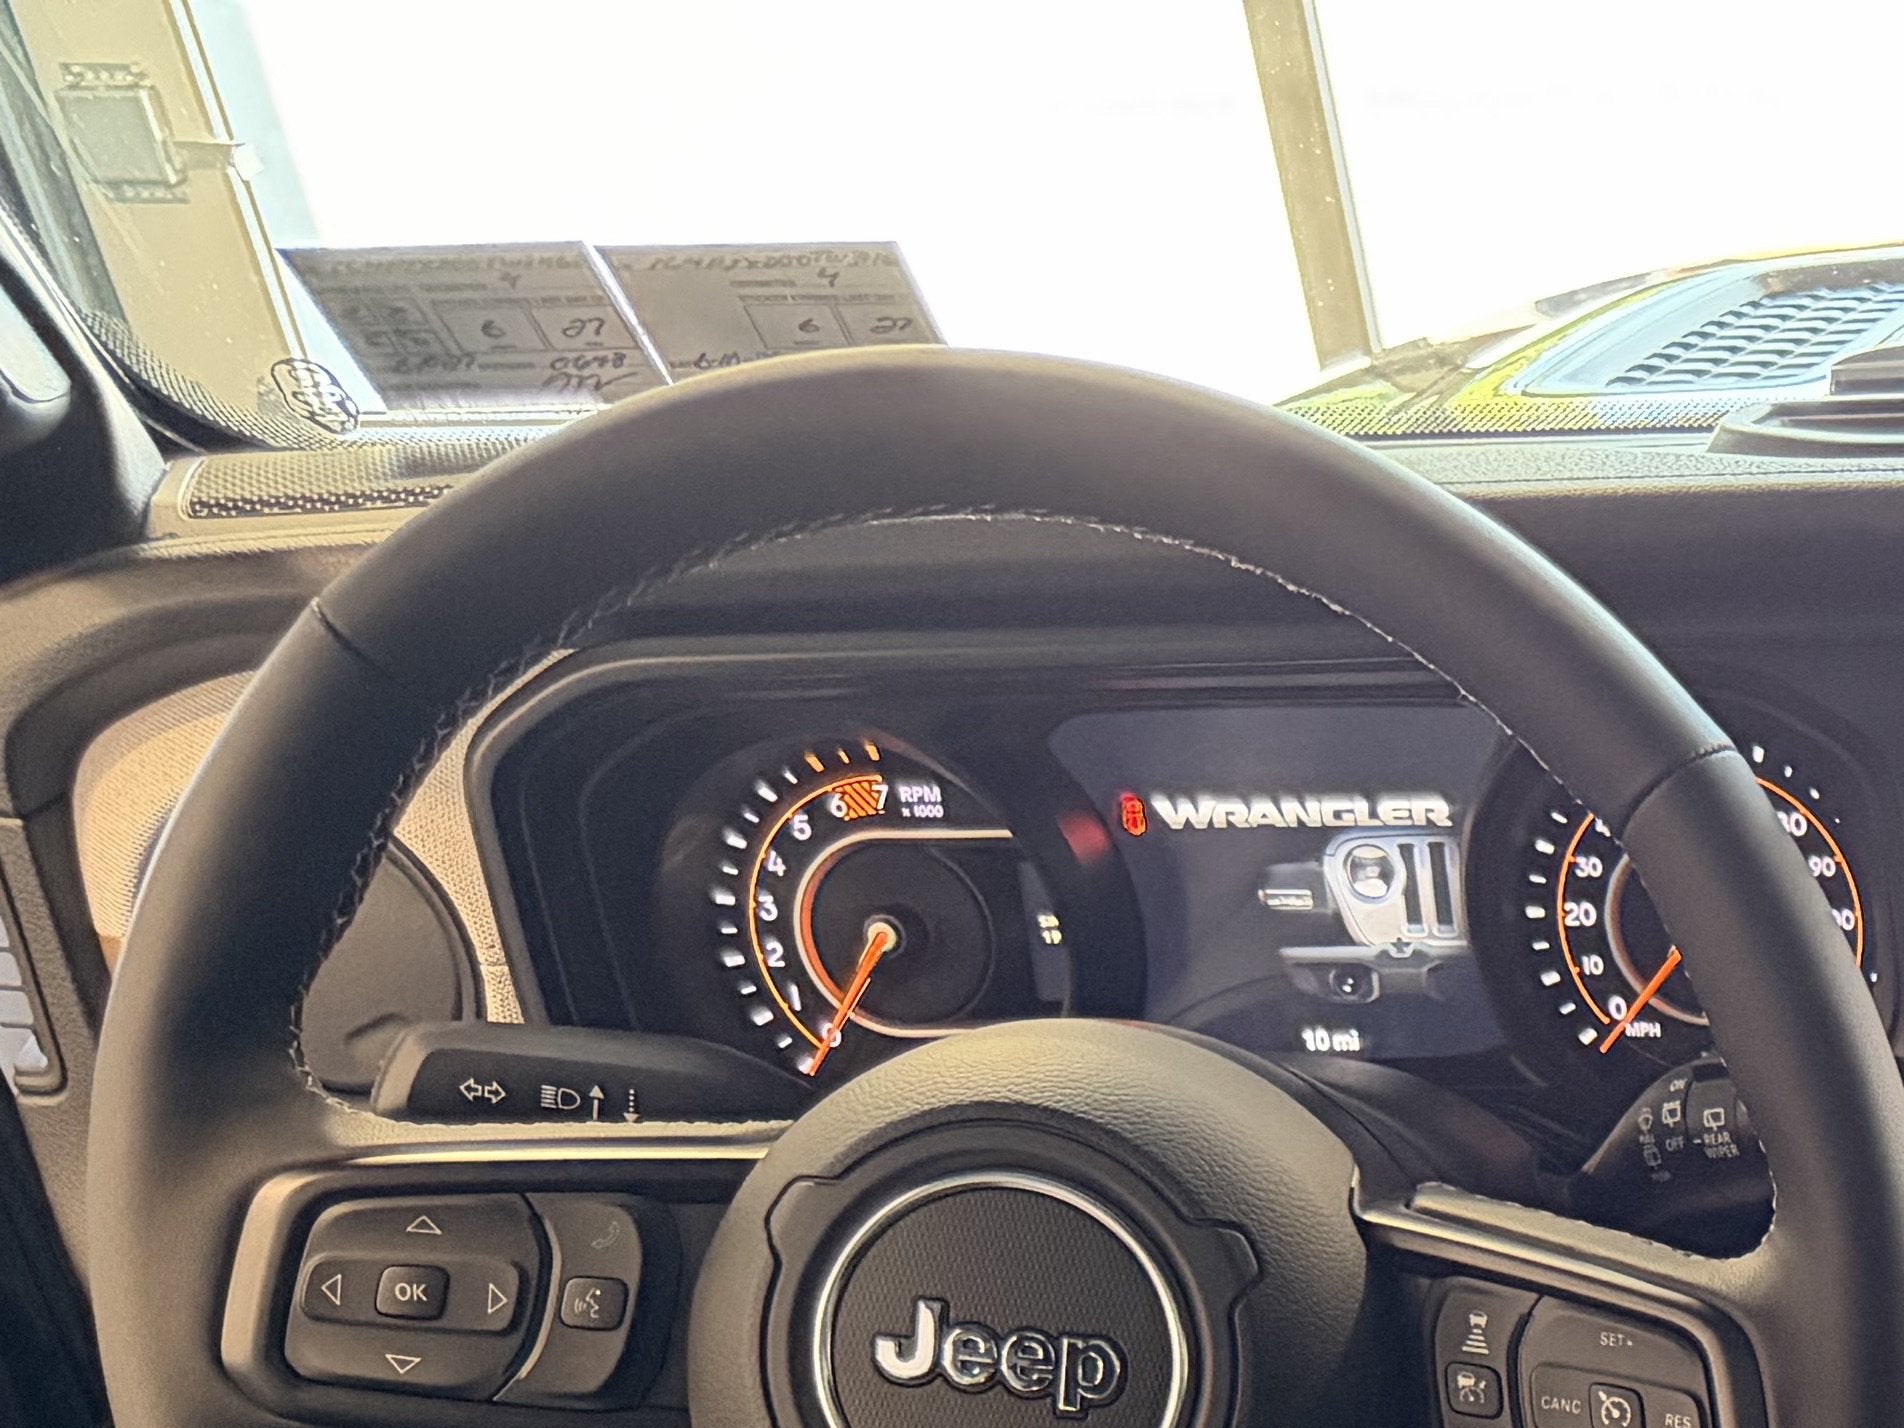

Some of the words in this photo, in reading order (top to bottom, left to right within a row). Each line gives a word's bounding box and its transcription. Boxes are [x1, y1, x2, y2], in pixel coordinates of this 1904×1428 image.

[798, 317, 821, 333] 6
[830, 791, 848, 818] 6
[873, 784, 889, 810] 7
[900, 785, 942, 803] RPM
[912, 805, 944, 818] 1000
[1152, 795, 1453, 829] WRANGLER
[793, 815, 812, 840] 5
[767, 851, 787, 877] 4
[1574, 855, 1603, 878] 30
[1808, 855, 1836, 877] 90
[757, 895, 779, 921] 3
[1563, 901, 1597, 927] 20
[764, 942, 785, 967] 2
[1582, 955, 1604, 976] 10
[787, 984, 802, 1011] 1
[1608, 994, 1628, 1021] 0
[1302, 1028, 1329, 1052] 10
[1333, 1028, 1361, 1052] mi
[1626, 1021, 1662, 1038] MPH
[1666, 1136, 1685, 1152] OFF
[394, 1283, 428, 1302] OK
[873, 1297, 1129, 1418] Jeep
[1541, 1396, 1582, 1415] CANC
